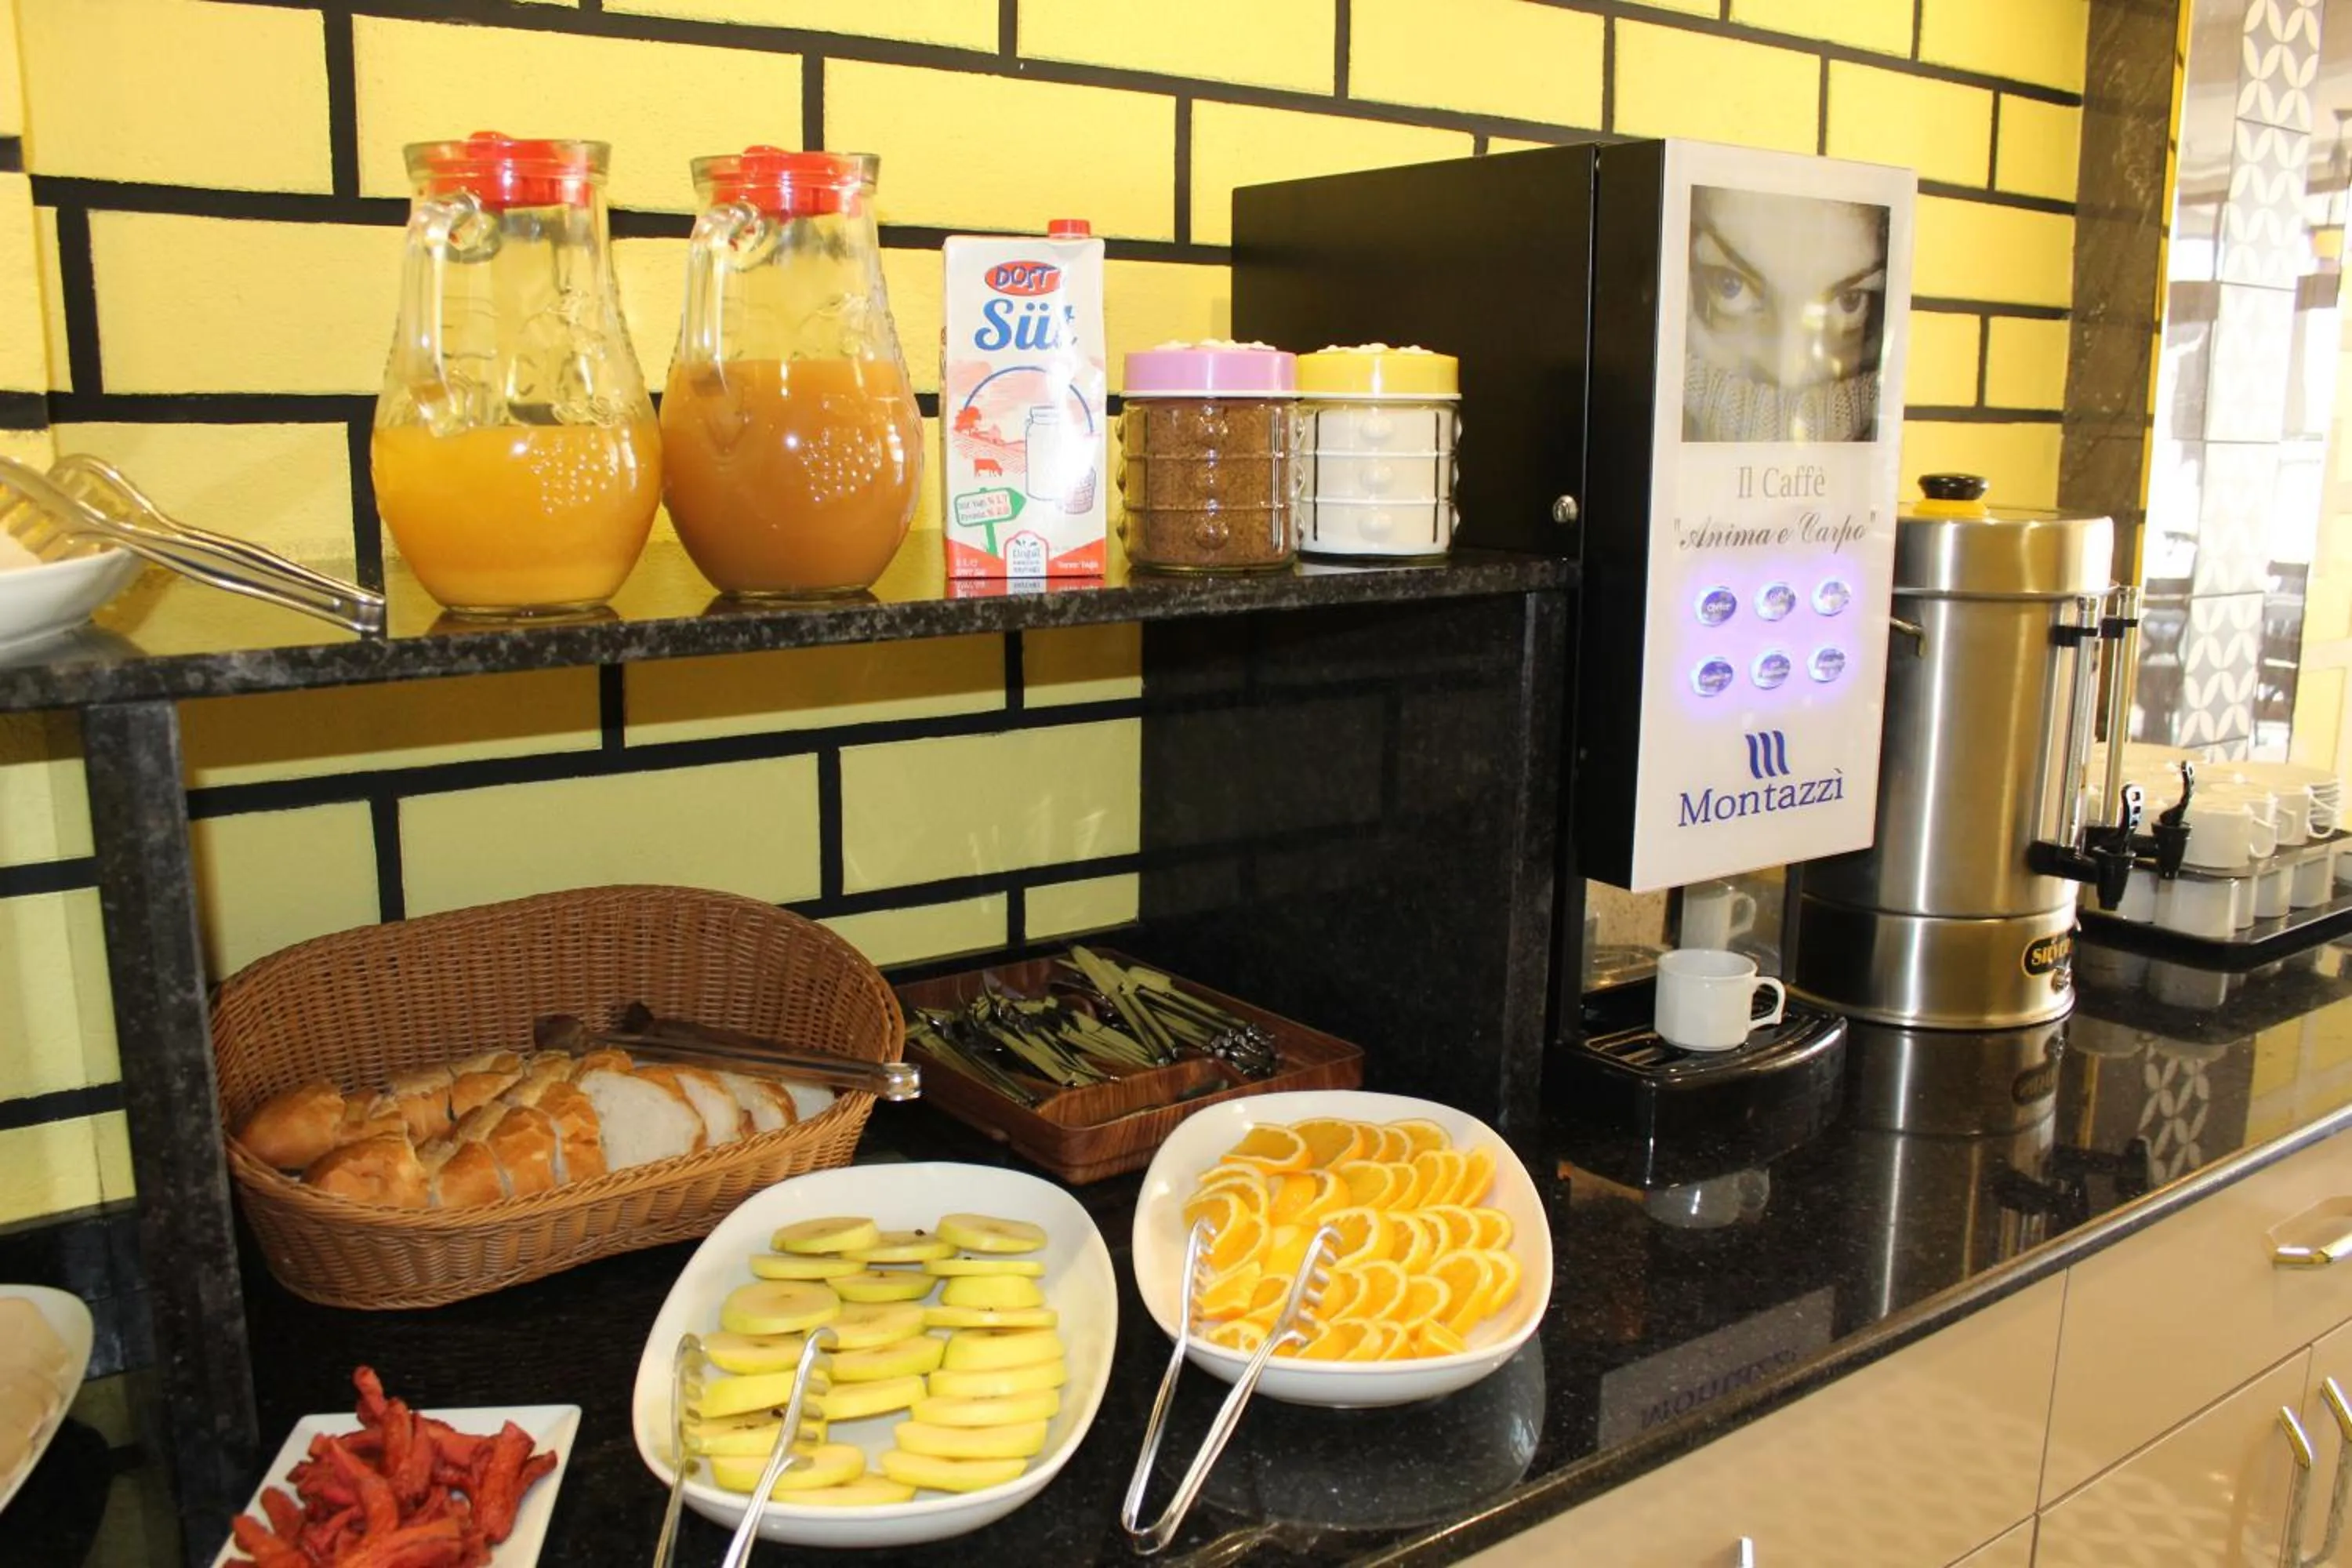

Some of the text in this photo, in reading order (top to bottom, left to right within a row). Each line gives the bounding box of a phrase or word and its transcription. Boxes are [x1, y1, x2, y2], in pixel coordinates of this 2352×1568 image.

[995, 265, 1060, 291] DOST
[1737, 465, 1826, 499] Il Caffè
